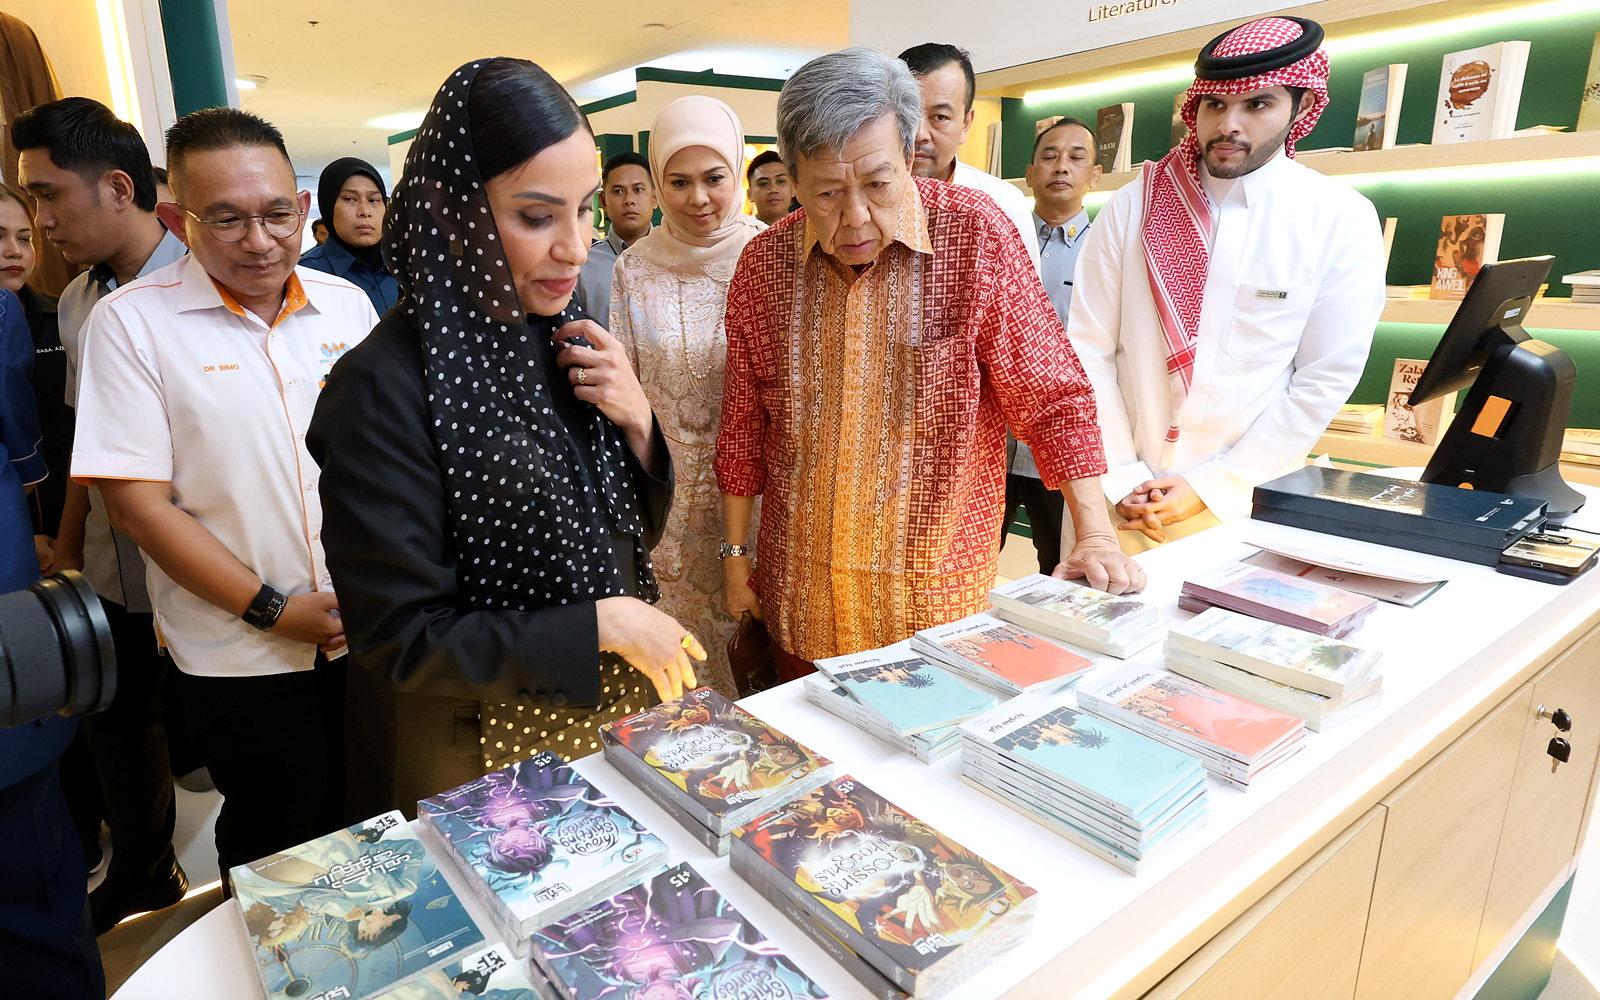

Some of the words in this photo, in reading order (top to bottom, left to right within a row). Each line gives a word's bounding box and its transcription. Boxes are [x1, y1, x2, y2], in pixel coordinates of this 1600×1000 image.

[1437, 267, 1458, 279] KING
[670, 870, 692, 887] +15
[823, 844, 914, 897] Crossing
[477, 951, 499, 971] +15
